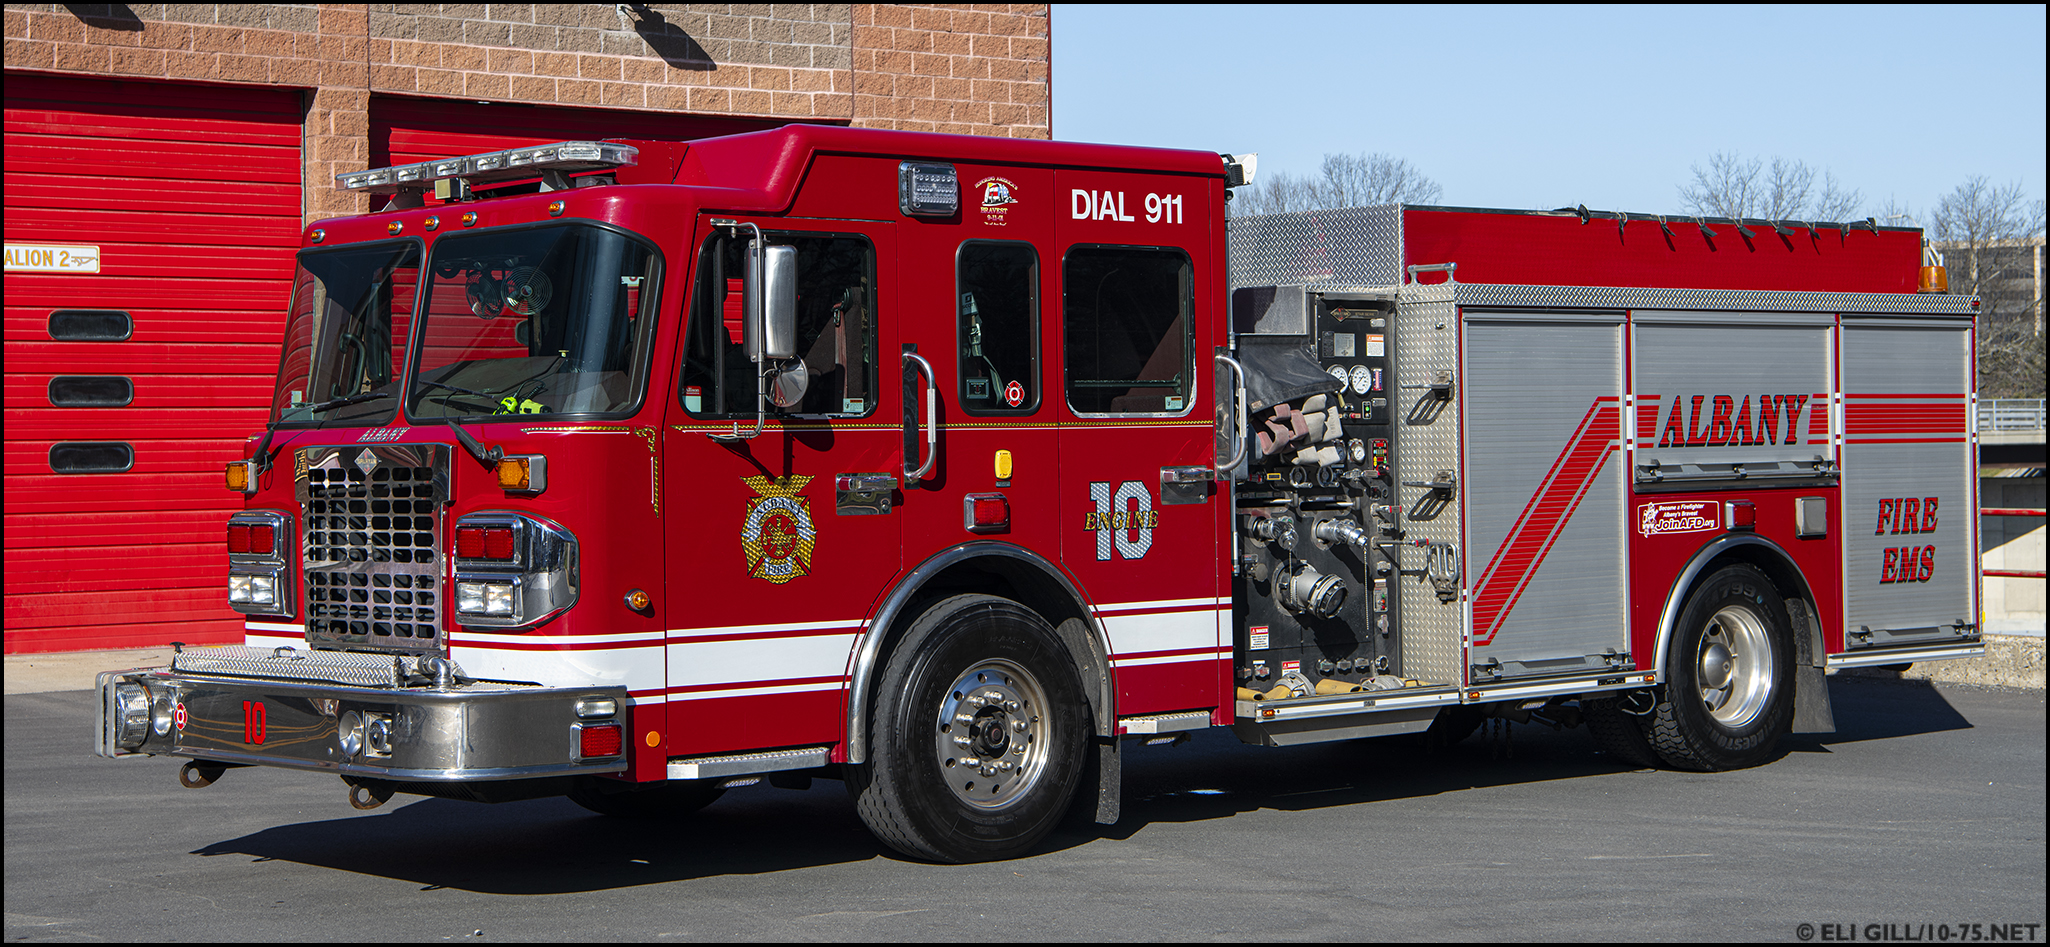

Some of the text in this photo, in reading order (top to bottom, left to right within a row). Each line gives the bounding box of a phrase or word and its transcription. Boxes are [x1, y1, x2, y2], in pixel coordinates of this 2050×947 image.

[980, 206, 1008, 214] BRAVEST
[1071, 188, 1183, 224] DIAL 911
[4, 248, 71, 267] ALION 2
[1658, 394, 1809, 448] ALBANY
[356, 427, 411, 443] ALBANY
[756, 499, 802, 516] ALBANY
[1681, 503, 1705, 511] Firefighter
[1874, 496, 1939, 536] FIRE
[1083, 510, 1159, 532] ENGINE
[1089, 480, 1153, 561] 10
[767, 562, 792, 574] FIRE
[1879, 544, 1936, 584] EMS
[242, 700, 267, 745] 10
